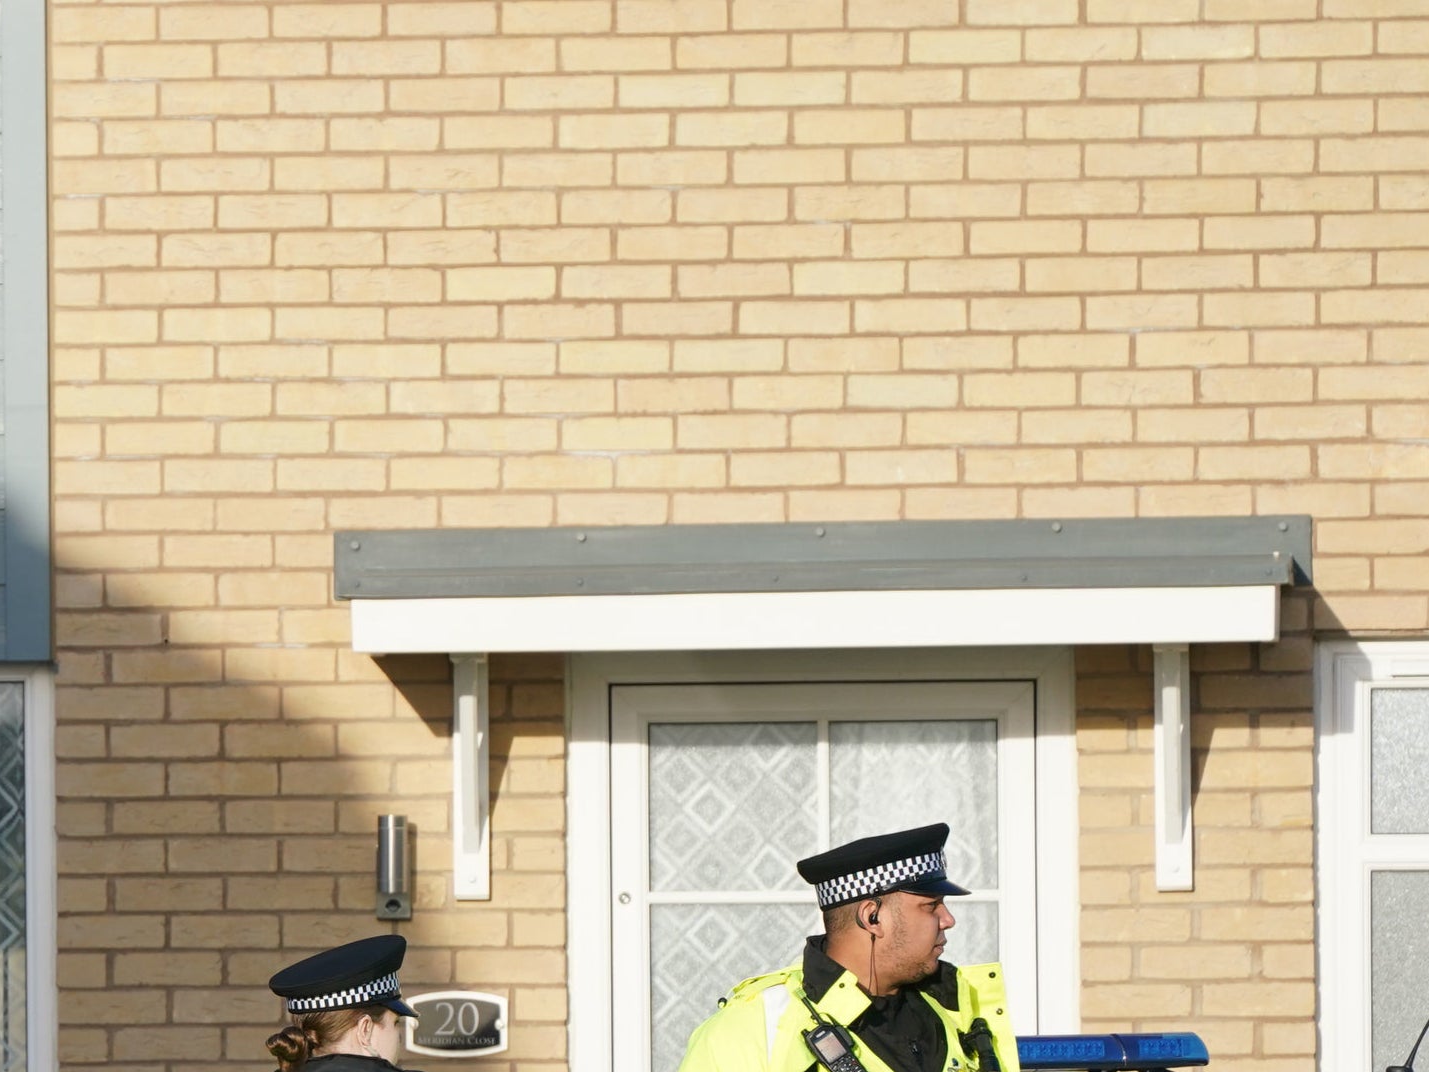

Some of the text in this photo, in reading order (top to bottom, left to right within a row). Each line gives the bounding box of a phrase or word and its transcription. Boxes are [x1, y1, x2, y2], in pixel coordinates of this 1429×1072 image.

[435, 1002, 479, 1035] 20
[417, 1036, 496, 1046] MERIDIAN CLOSE
